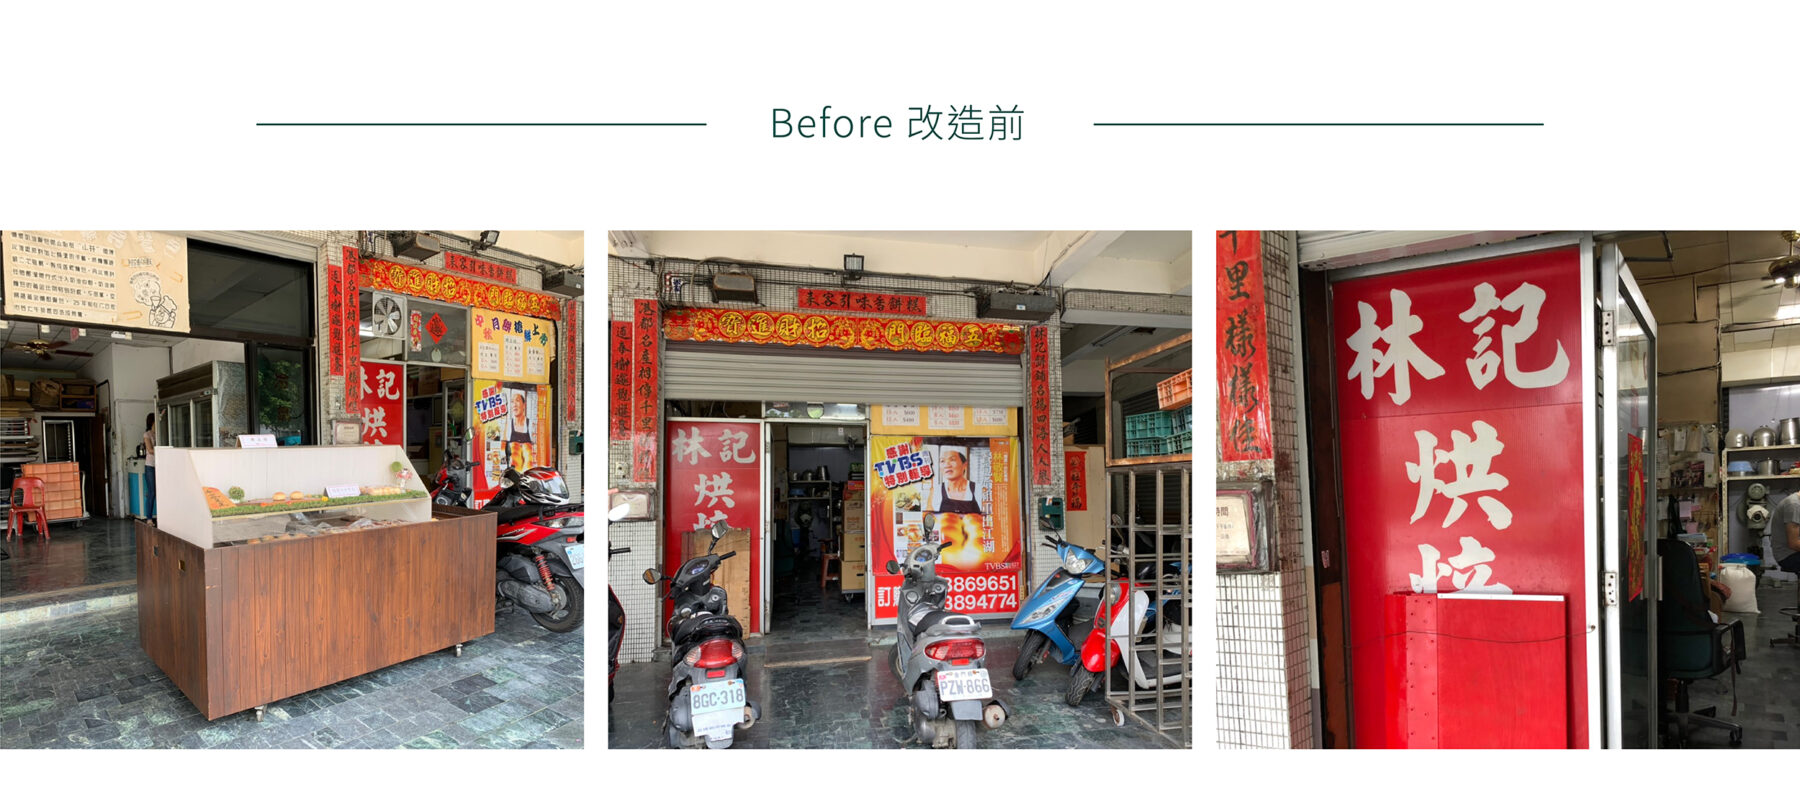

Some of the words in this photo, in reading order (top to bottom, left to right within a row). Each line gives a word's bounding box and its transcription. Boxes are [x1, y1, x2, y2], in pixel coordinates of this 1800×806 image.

[1346, 281, 1570, 406] 林記
[475, 394, 502, 412] TVBS
[361, 406, 388, 445] 烘
[671, 426, 756, 465] 林記
[886, 442, 909, 459] 感謝
[875, 452, 923, 476] TVBS
[884, 465, 931, 487] 特別報導
[944, 593, 1018, 610] 3894774
